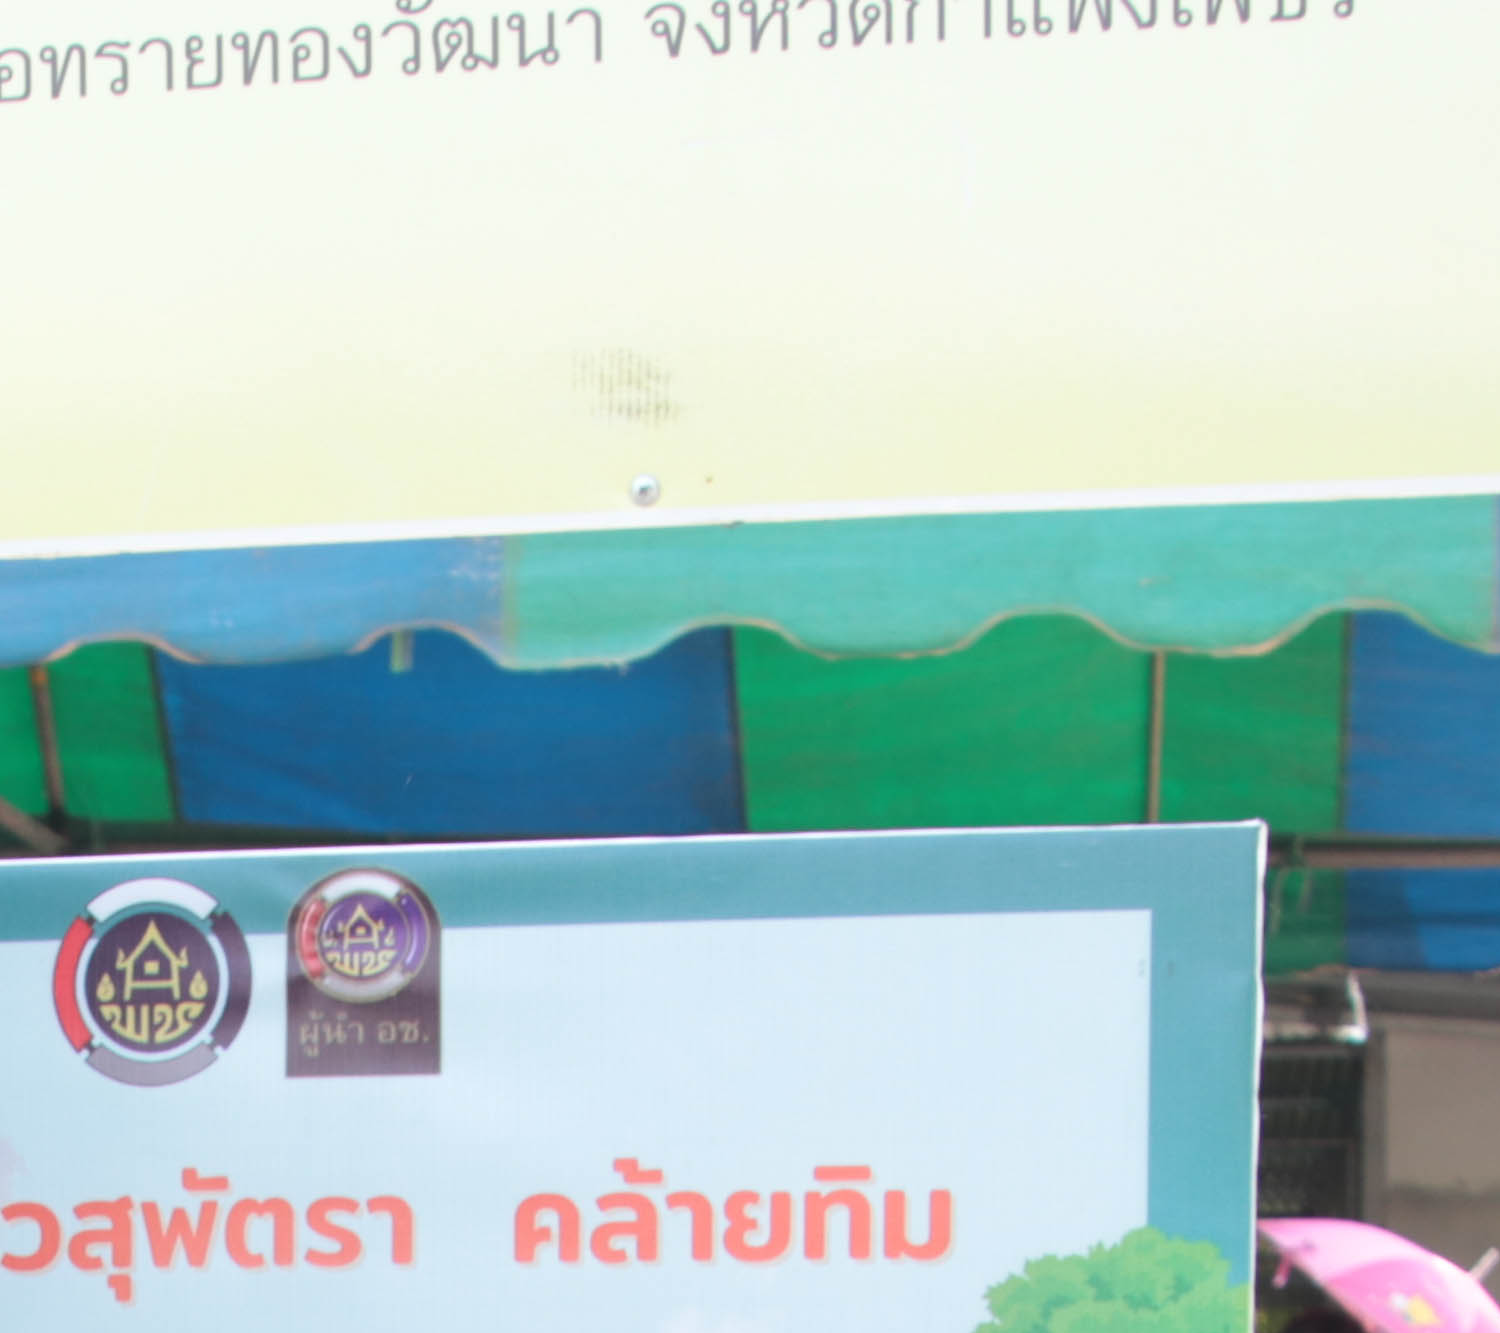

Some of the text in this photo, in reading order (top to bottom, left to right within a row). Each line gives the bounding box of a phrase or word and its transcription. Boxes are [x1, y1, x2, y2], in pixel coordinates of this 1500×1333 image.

[299, 1009, 366, 1057] ผู้นำ
[513, 1157, 952, 1263] คล้ายทิม
